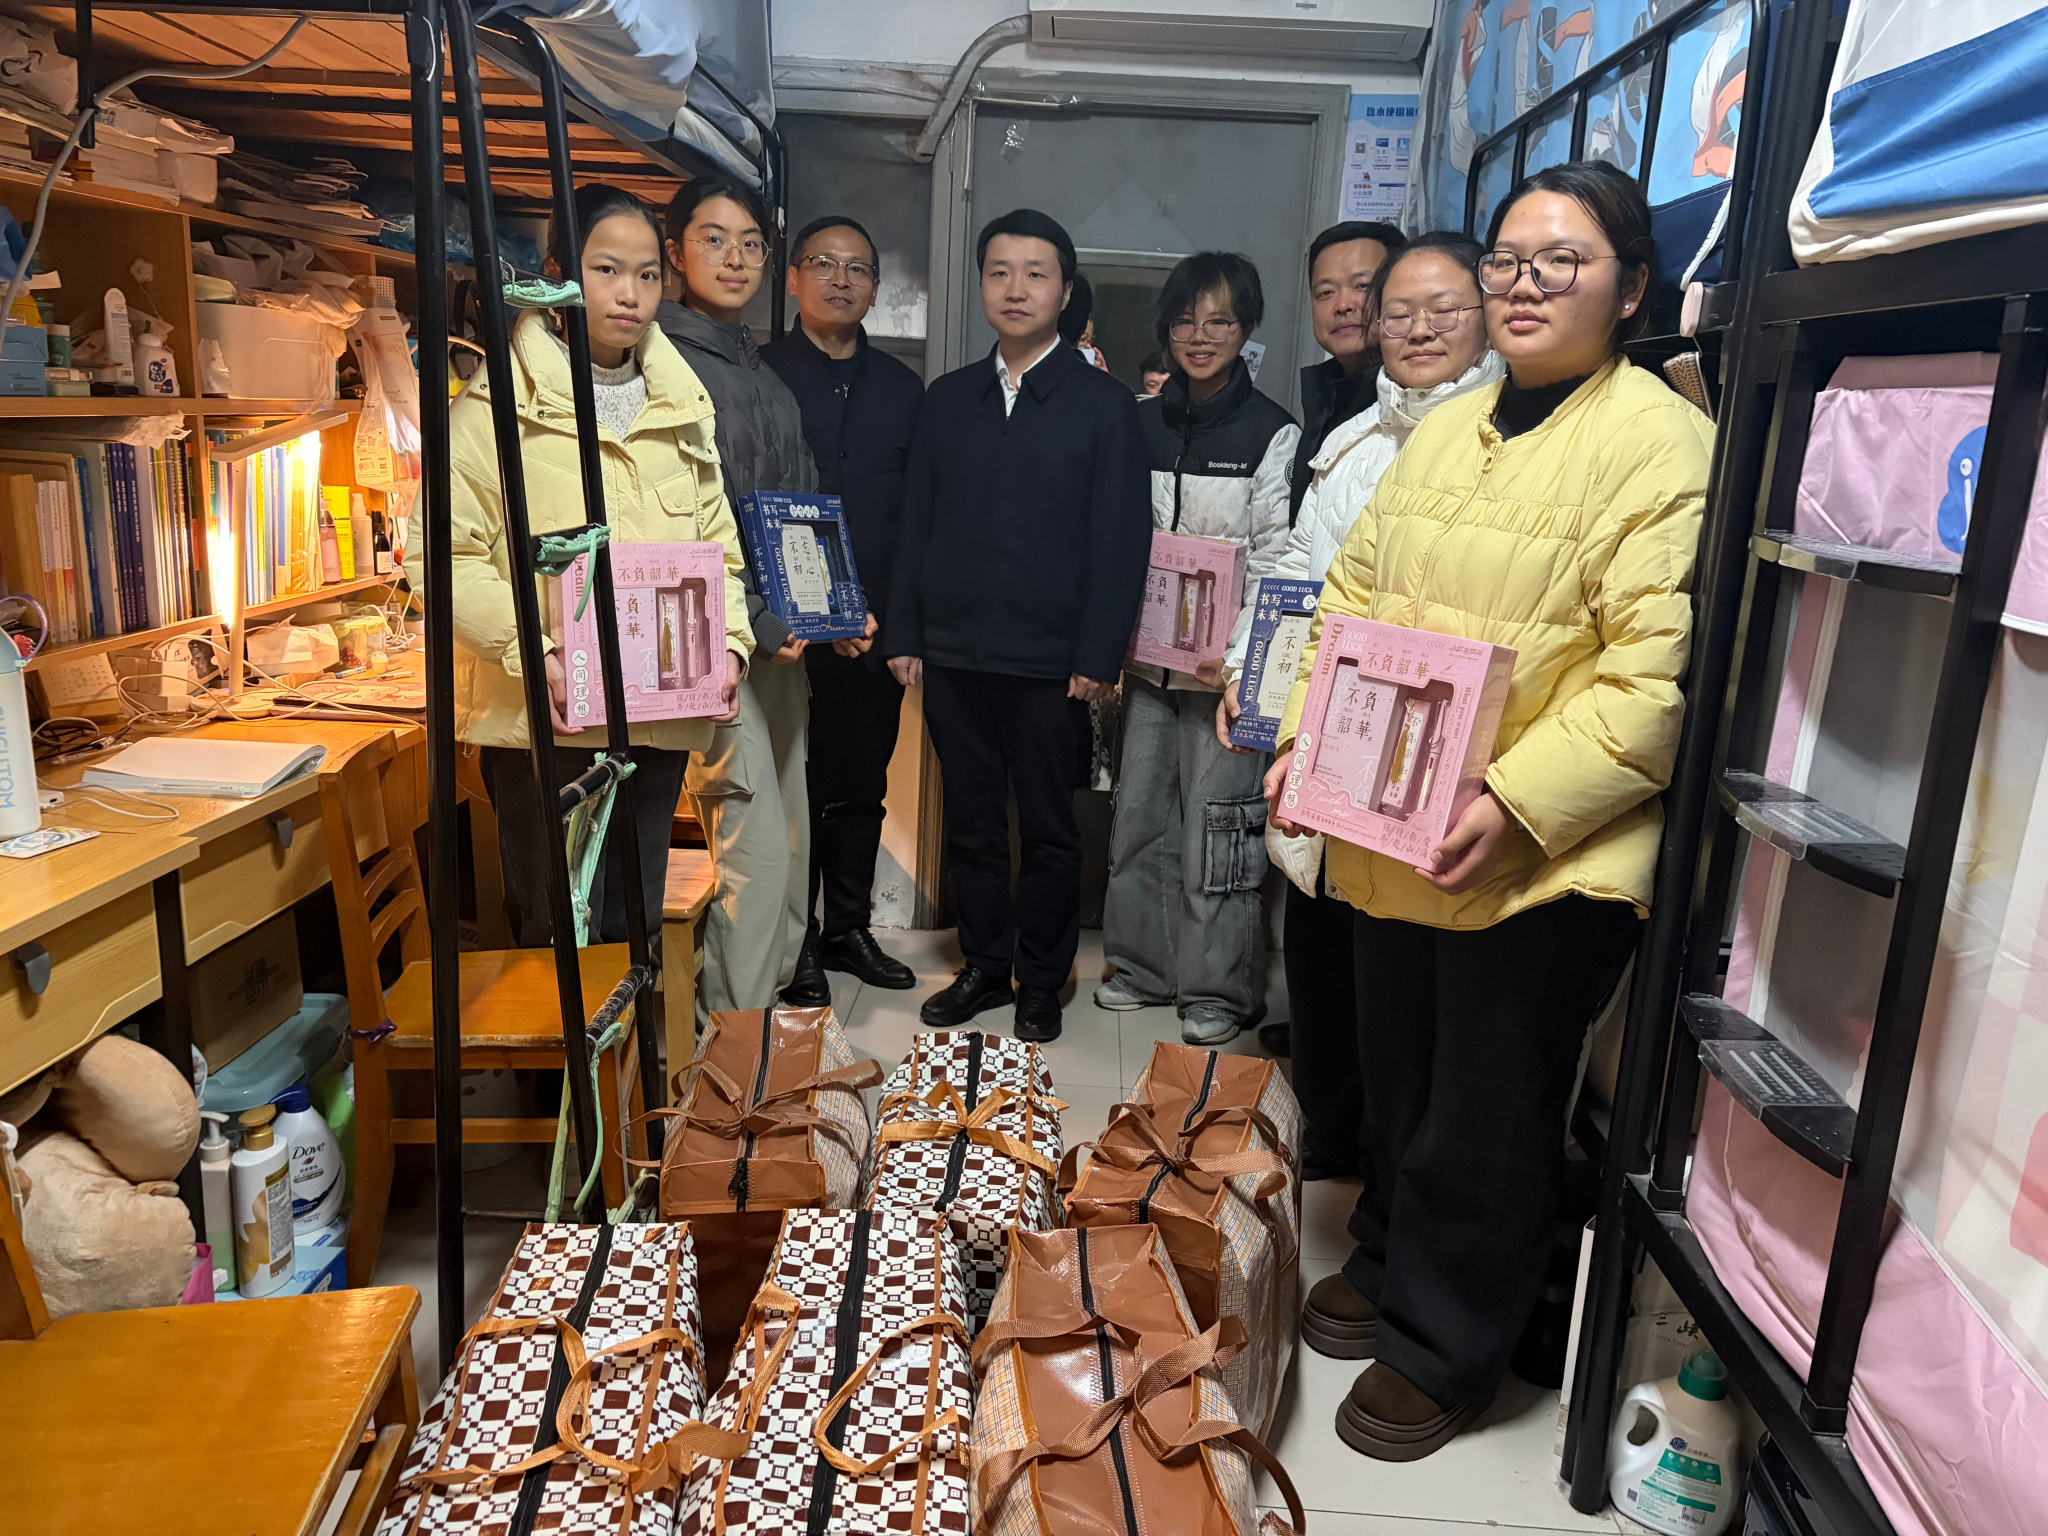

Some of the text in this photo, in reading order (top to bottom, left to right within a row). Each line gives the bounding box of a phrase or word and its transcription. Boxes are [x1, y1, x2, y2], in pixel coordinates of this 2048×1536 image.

[1366, 106, 1418, 117] 热水使用说
[774, 547, 792, 603] GOOD LUCK
[1281, 585, 1298, 593] GOOD
[1260, 593, 1282, 606] 书写
[1256, 608, 1279, 621] 未来
[1344, 629, 1368, 642] GOOD
[1321, 623, 1344, 675] Dream
[1341, 640, 1365, 652] LUCK
[1244, 641, 1264, 702] GOOD LUCK
[573, 652, 588, 716] 人间理想
[1462, 686, 1472, 705] What
[1285, 736, 1310, 808] 人间理想
[1308, 782, 1346, 805] Touch
[1331, 808, 1350, 818] me
[292, 1142, 325, 1160] Dove
